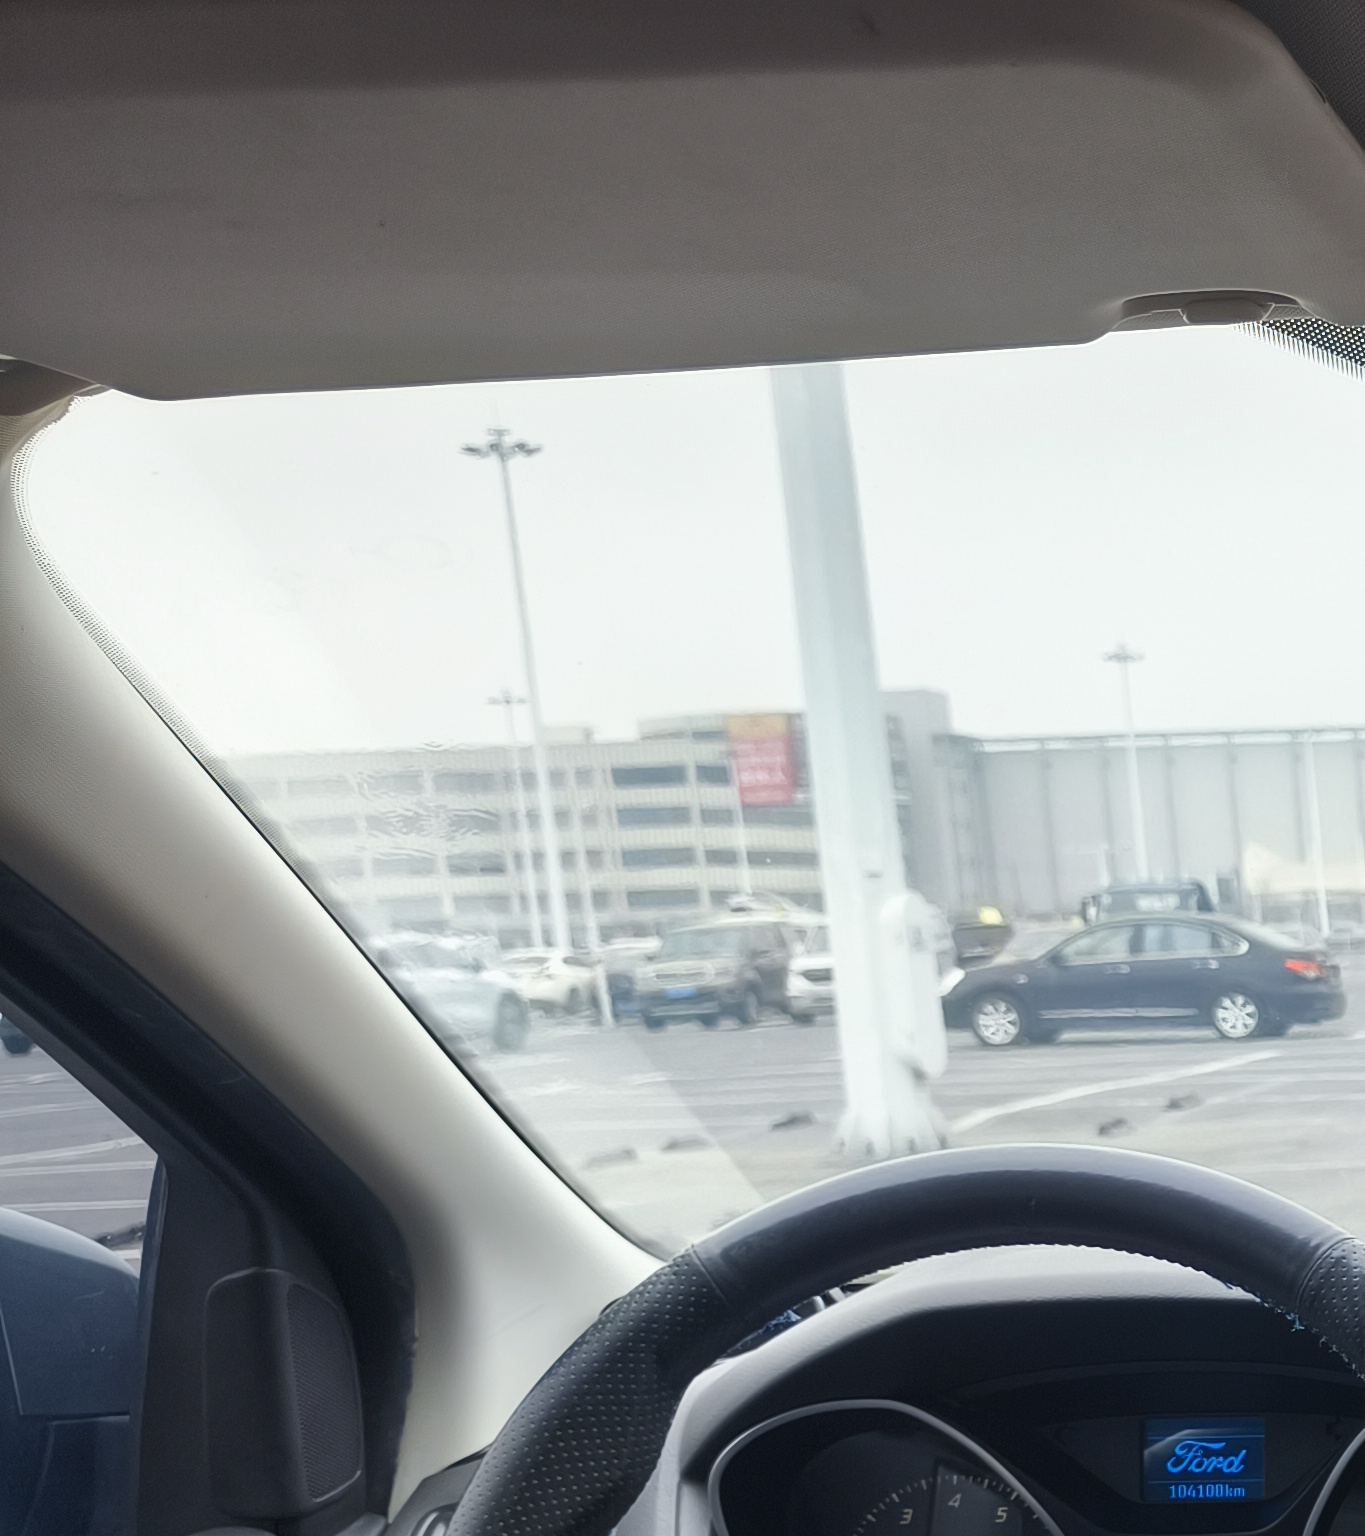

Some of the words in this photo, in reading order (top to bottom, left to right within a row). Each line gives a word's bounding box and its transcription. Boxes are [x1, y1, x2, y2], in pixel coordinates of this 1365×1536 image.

[1165, 1440, 1247, 1473] Ford
[947, 1493, 962, 1509] 4
[899, 1508, 914, 1525] 3
[995, 1507, 1009, 1523] 5
